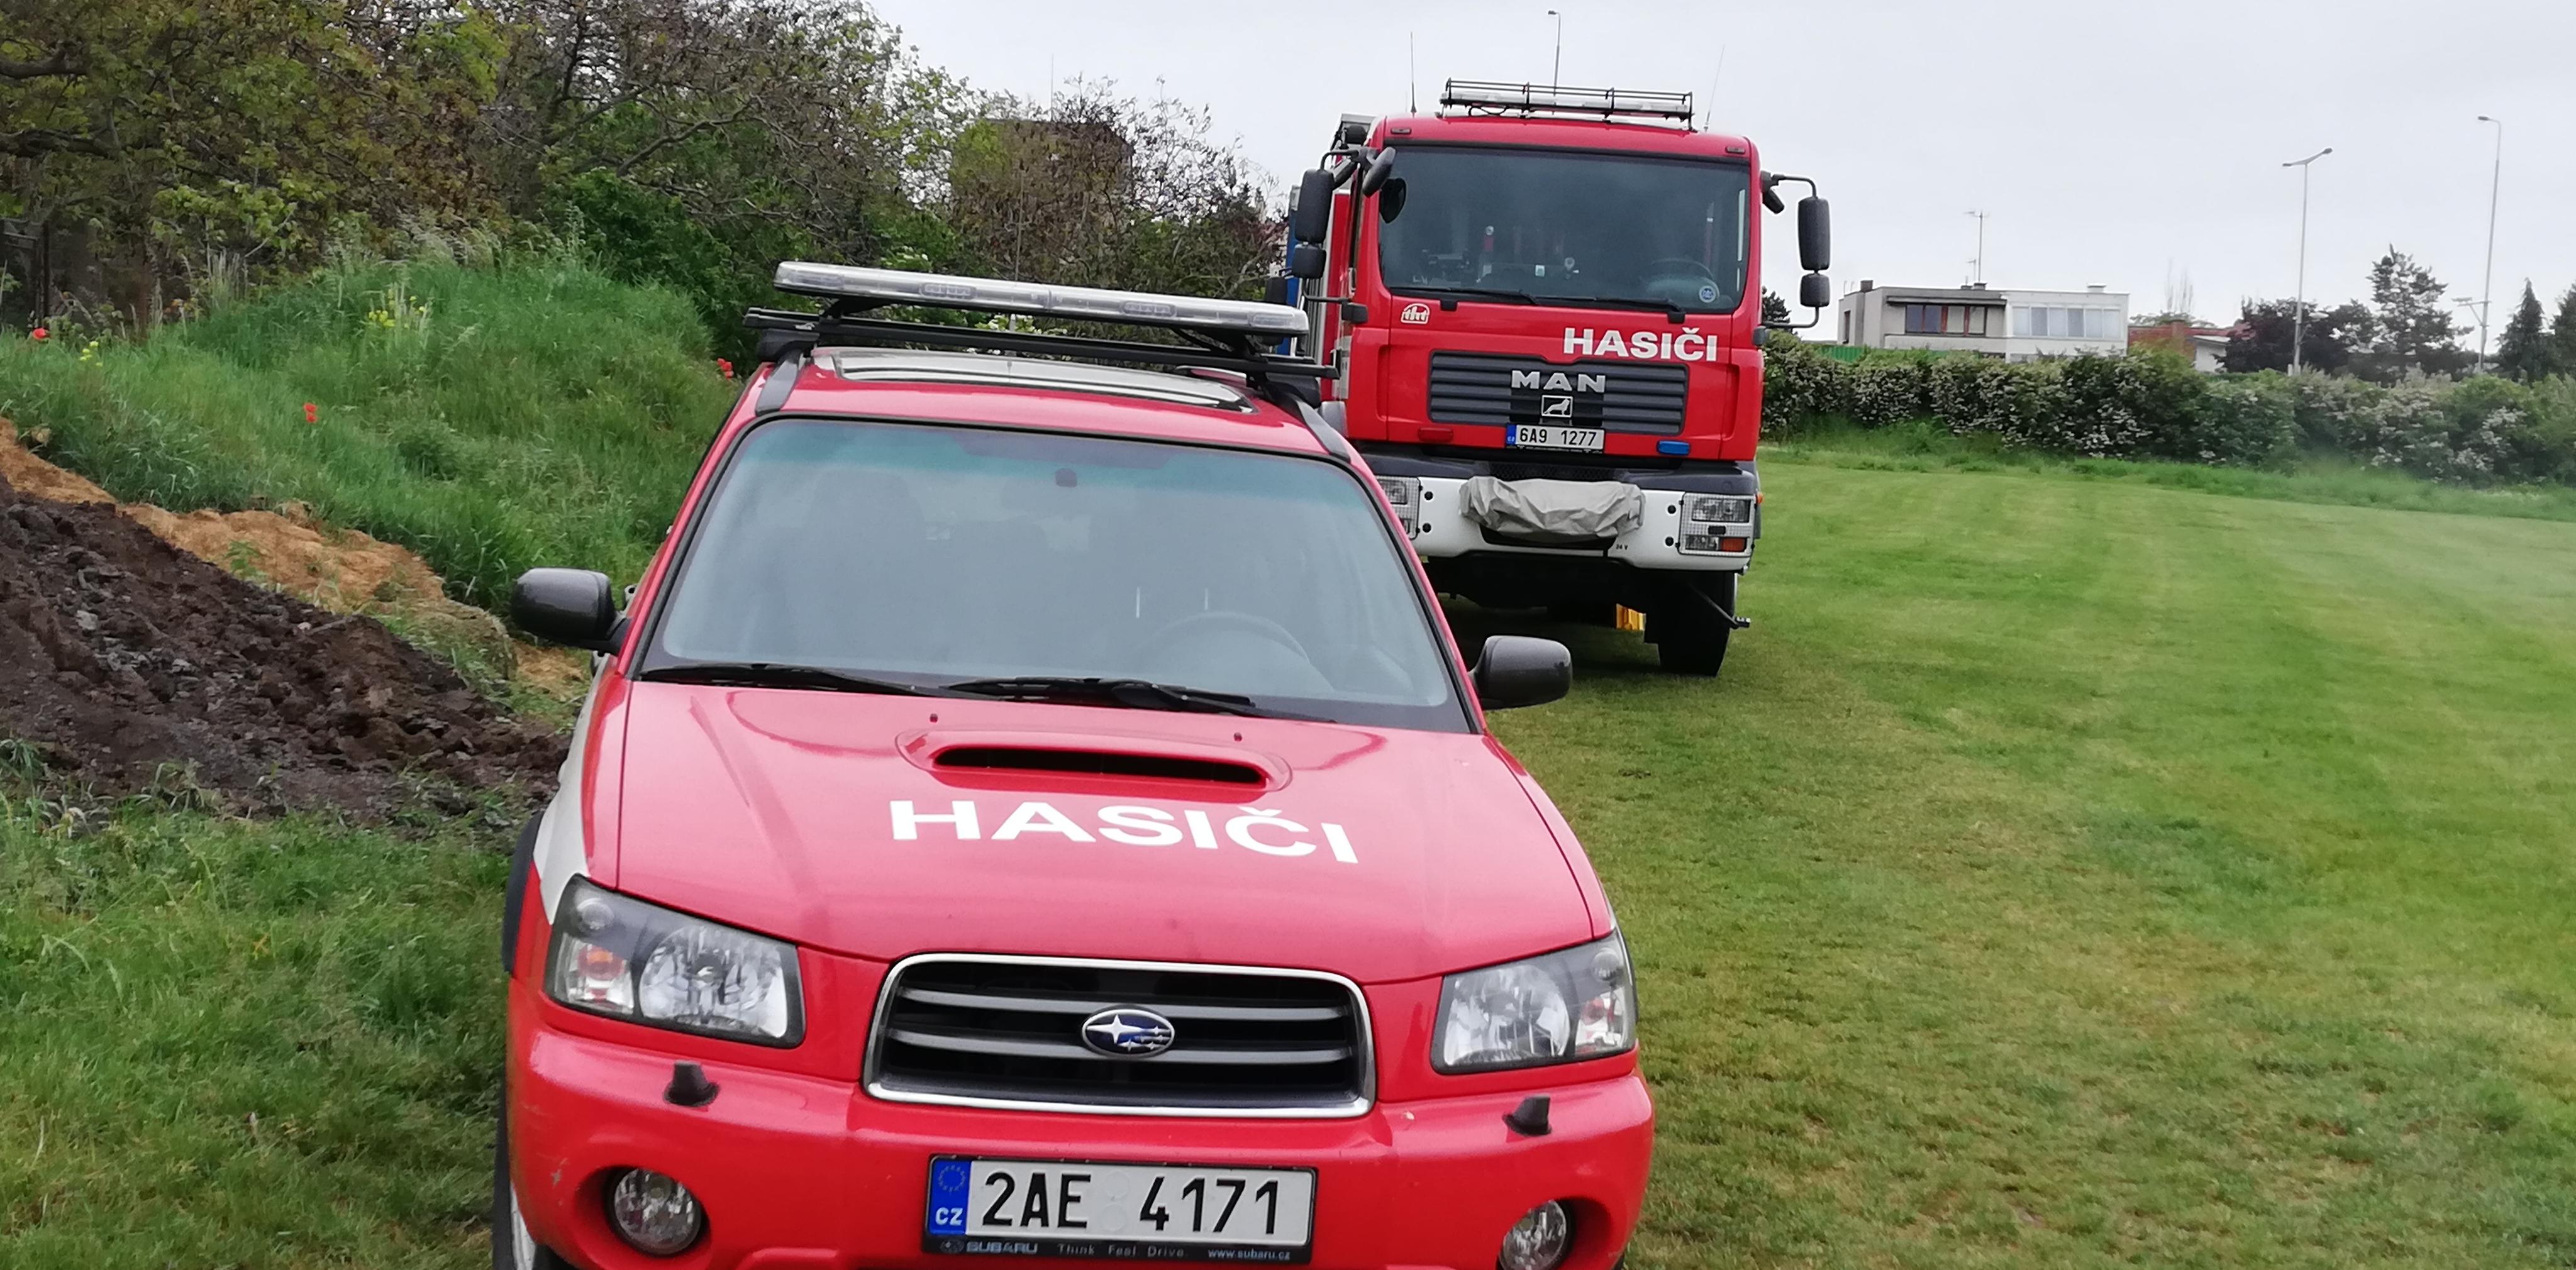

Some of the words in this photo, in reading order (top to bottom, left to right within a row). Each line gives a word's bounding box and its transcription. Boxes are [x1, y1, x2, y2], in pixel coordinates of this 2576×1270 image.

[1563, 328, 1718, 362] HASIČI
[1511, 370, 1606, 393] MAN
[1519, 428, 1548, 443] 6A9
[1560, 430, 1597, 446] 1277
[889, 800, 1359, 864] HASIČI
[982, 1172, 1092, 1229] 2AE
[1140, 1176, 1279, 1235] 4171
[935, 1207, 963, 1225] CZ
[966, 1240, 1038, 1254] SUBARU
[1208, 1247, 1291, 1261] www.subaru.cz
